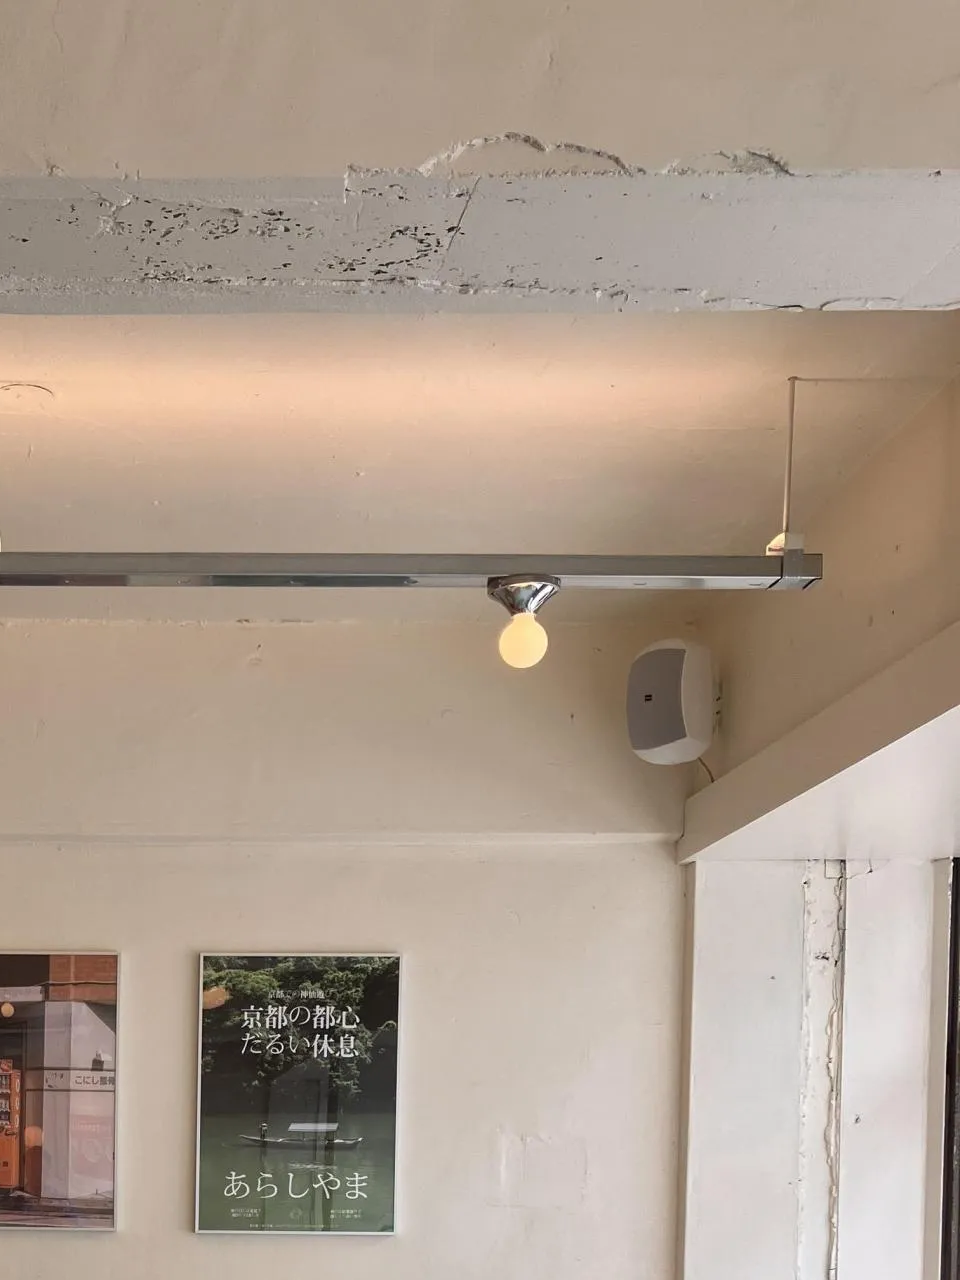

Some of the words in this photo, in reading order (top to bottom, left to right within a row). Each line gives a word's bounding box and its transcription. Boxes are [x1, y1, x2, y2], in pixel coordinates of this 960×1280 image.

[241, 1005, 360, 1030] 京都の都心
[241, 1033, 359, 1058] だるい休息
[224, 1171, 369, 1200] あらしやま
